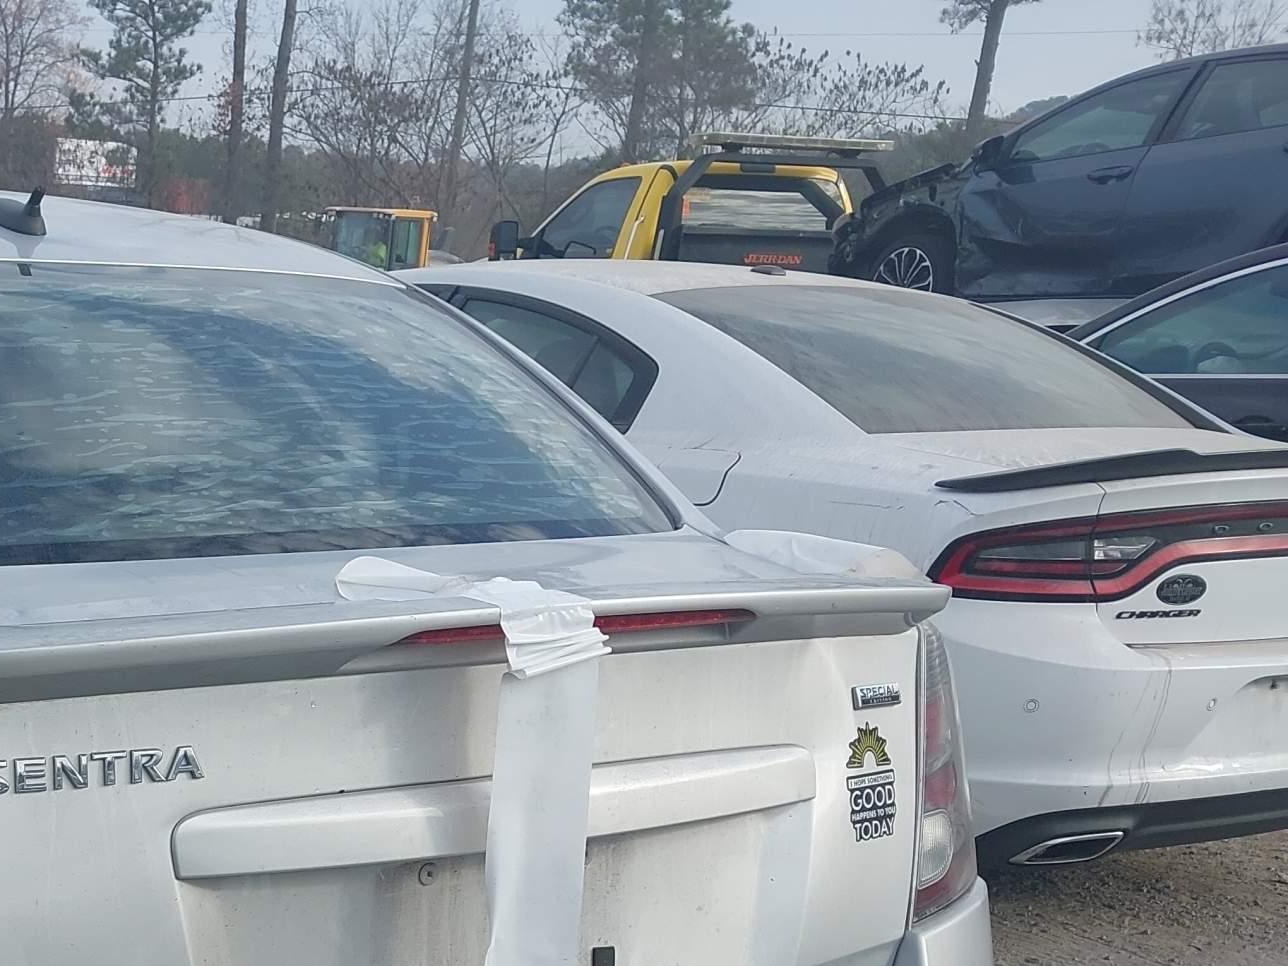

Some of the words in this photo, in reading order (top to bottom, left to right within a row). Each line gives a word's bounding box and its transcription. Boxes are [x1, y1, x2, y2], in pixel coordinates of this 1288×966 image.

[1115, 609, 1201, 620] CHARGER
[859, 684, 900, 698] SPECIAL
[851, 785, 894, 810] GOOD
[851, 809, 877, 822] HAPPENS
[877, 808, 885, 817] TO
[885, 805, 896, 816] YOU
[854, 817, 894, 840] TODAY
